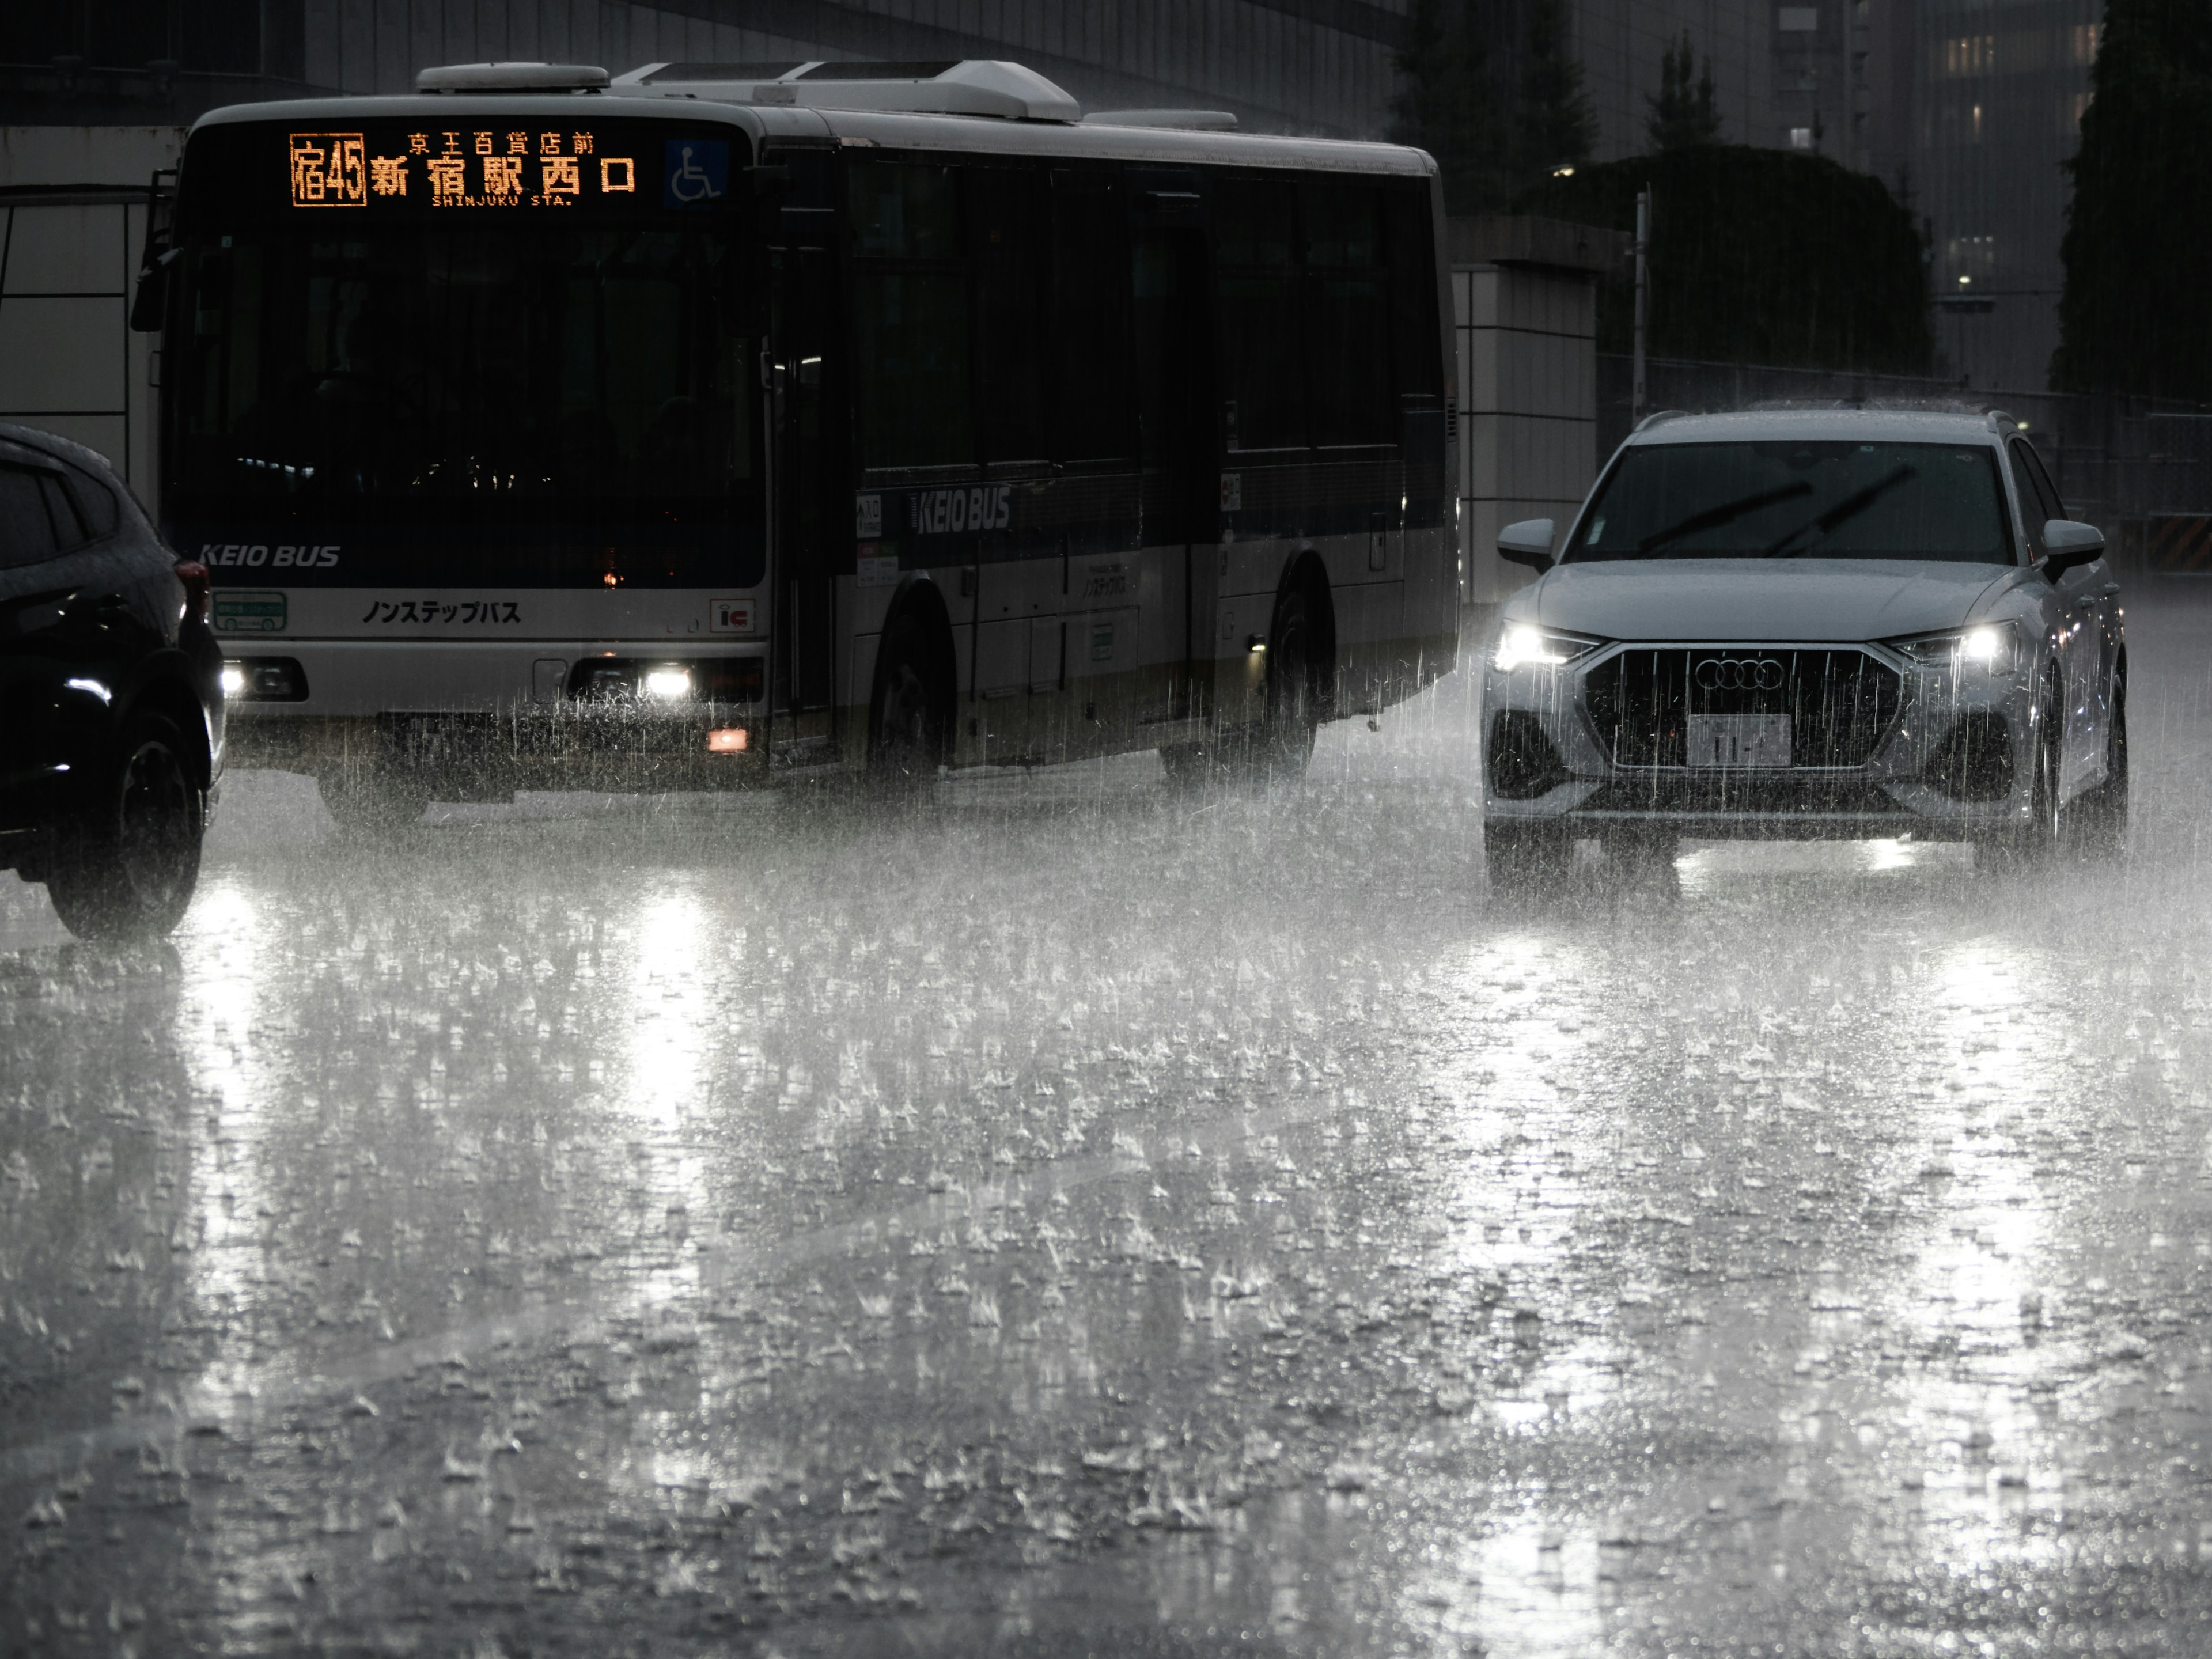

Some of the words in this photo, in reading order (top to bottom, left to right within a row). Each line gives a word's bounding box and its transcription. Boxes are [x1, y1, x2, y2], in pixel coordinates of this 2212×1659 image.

[407, 132, 594, 156] 京王百貨店前
[294, 139, 362, 200] 宿45
[370, 155, 635, 196] 新宿駅西口
[431, 195, 519, 207] SHINJUKU
[531, 195, 571, 207] STA.
[918, 489, 966, 535] KEIO
[967, 487, 1010, 531] BUS
[199, 544, 269, 567] KEIO
[272, 545, 342, 567] BUS
[362, 601, 521, 624] ノンステップバス
